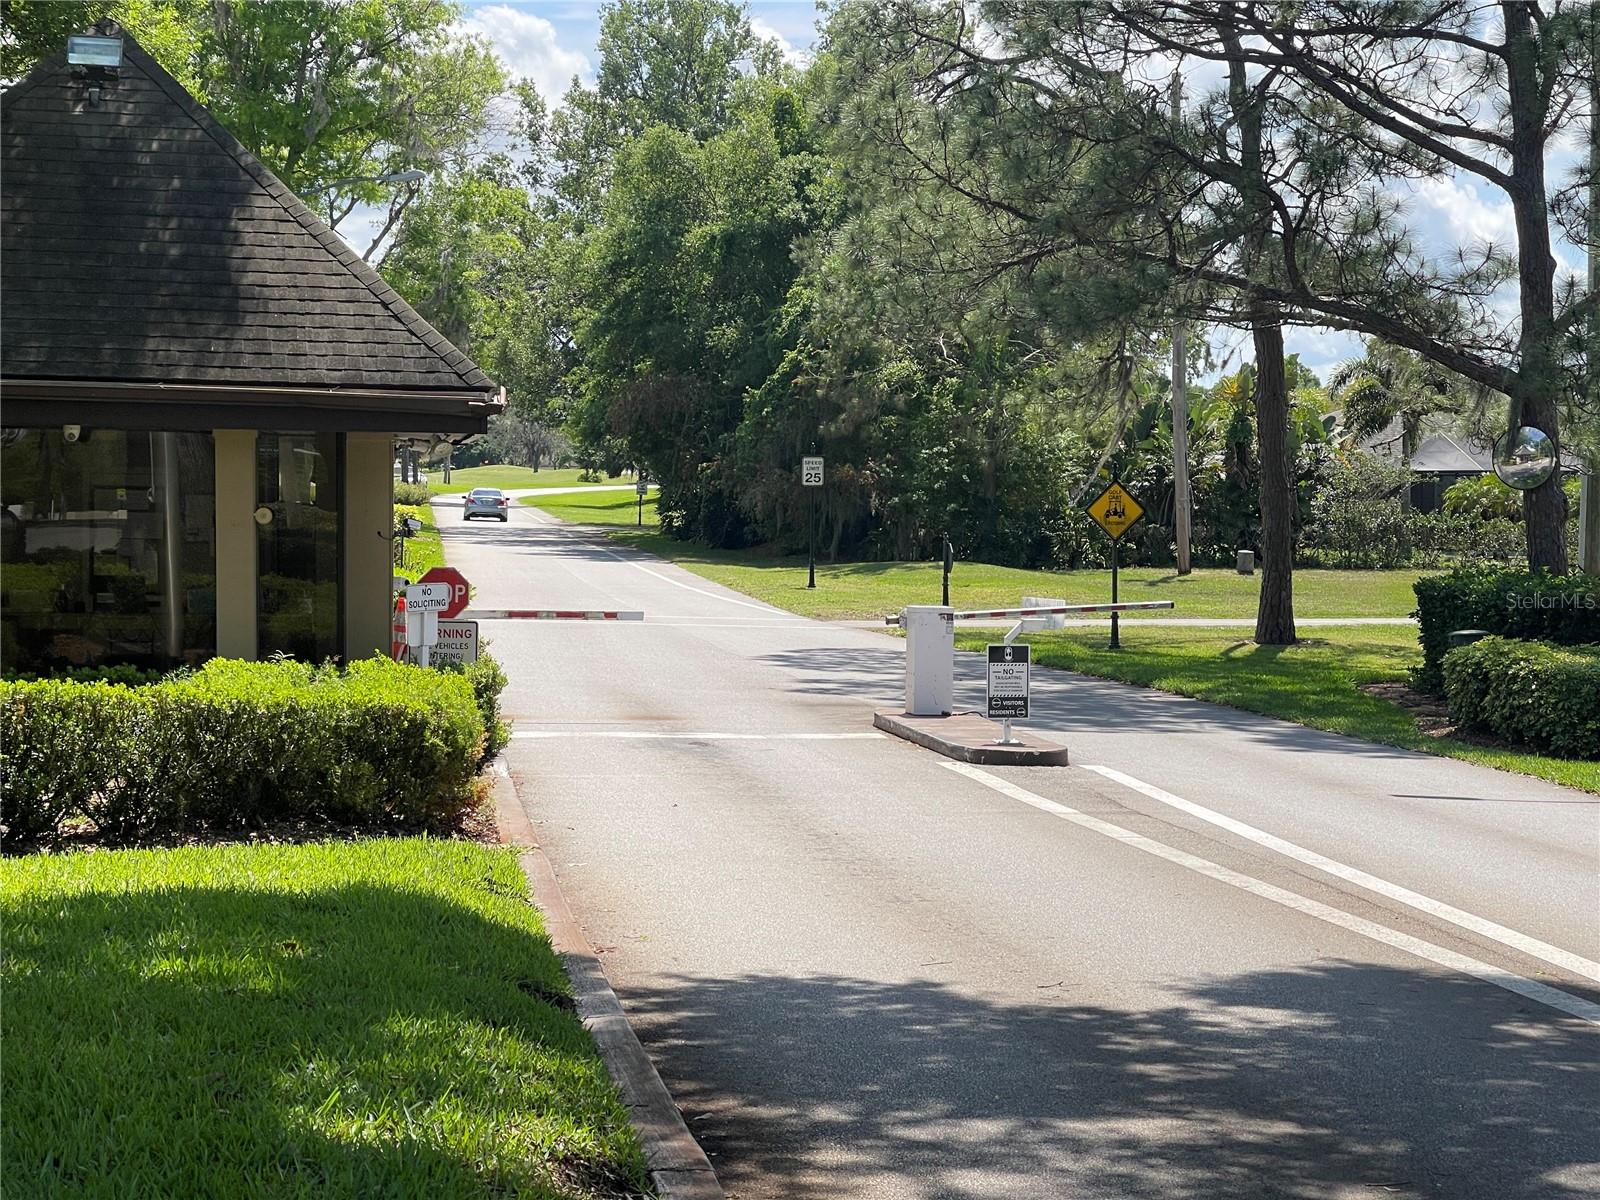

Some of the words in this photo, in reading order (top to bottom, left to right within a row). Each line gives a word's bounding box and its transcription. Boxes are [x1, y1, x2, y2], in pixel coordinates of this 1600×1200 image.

[805, 472, 821, 482] 25
[421, 588, 432, 596] NO
[408, 598, 446, 609] SOLICITING
[438, 629, 472, 639] RNING
